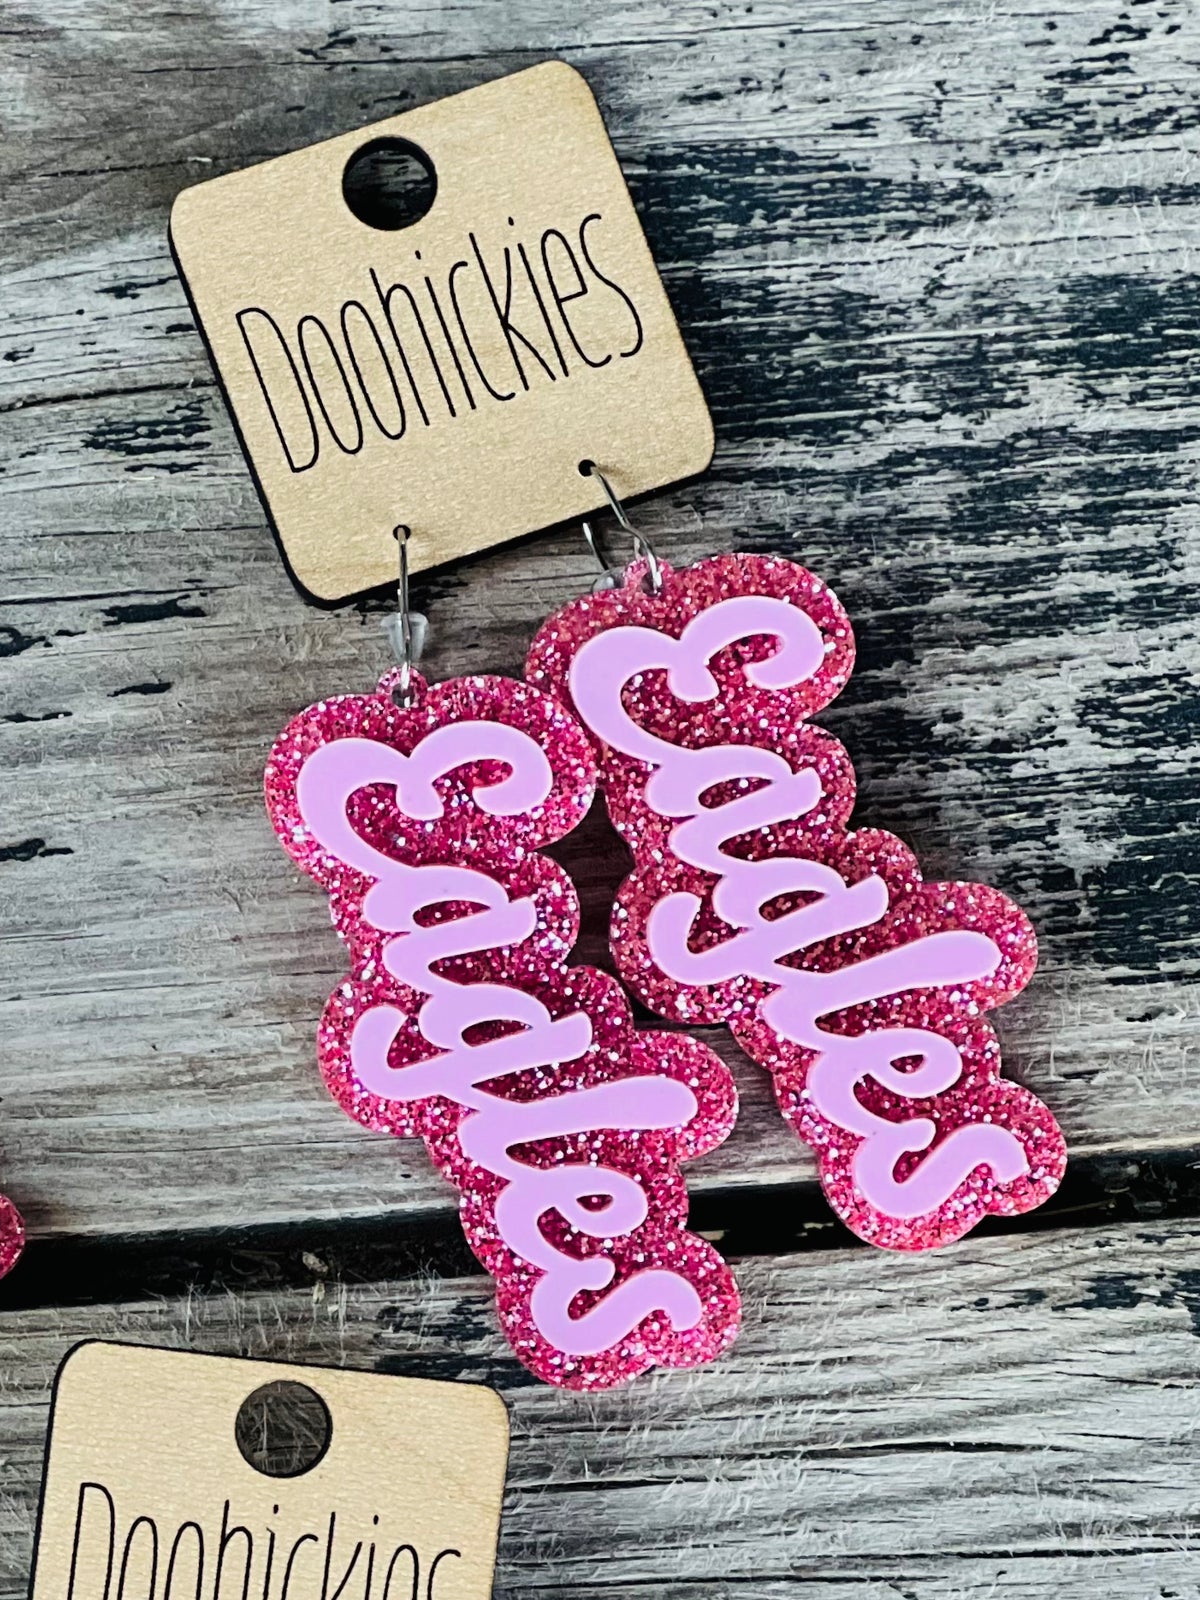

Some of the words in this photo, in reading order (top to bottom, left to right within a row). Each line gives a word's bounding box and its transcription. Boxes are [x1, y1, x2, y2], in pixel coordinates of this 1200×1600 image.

[235, 213, 644, 474] Doohickies
[297, 721, 703, 1356] Eagles
[571, 596, 1026, 1219] Eagles
